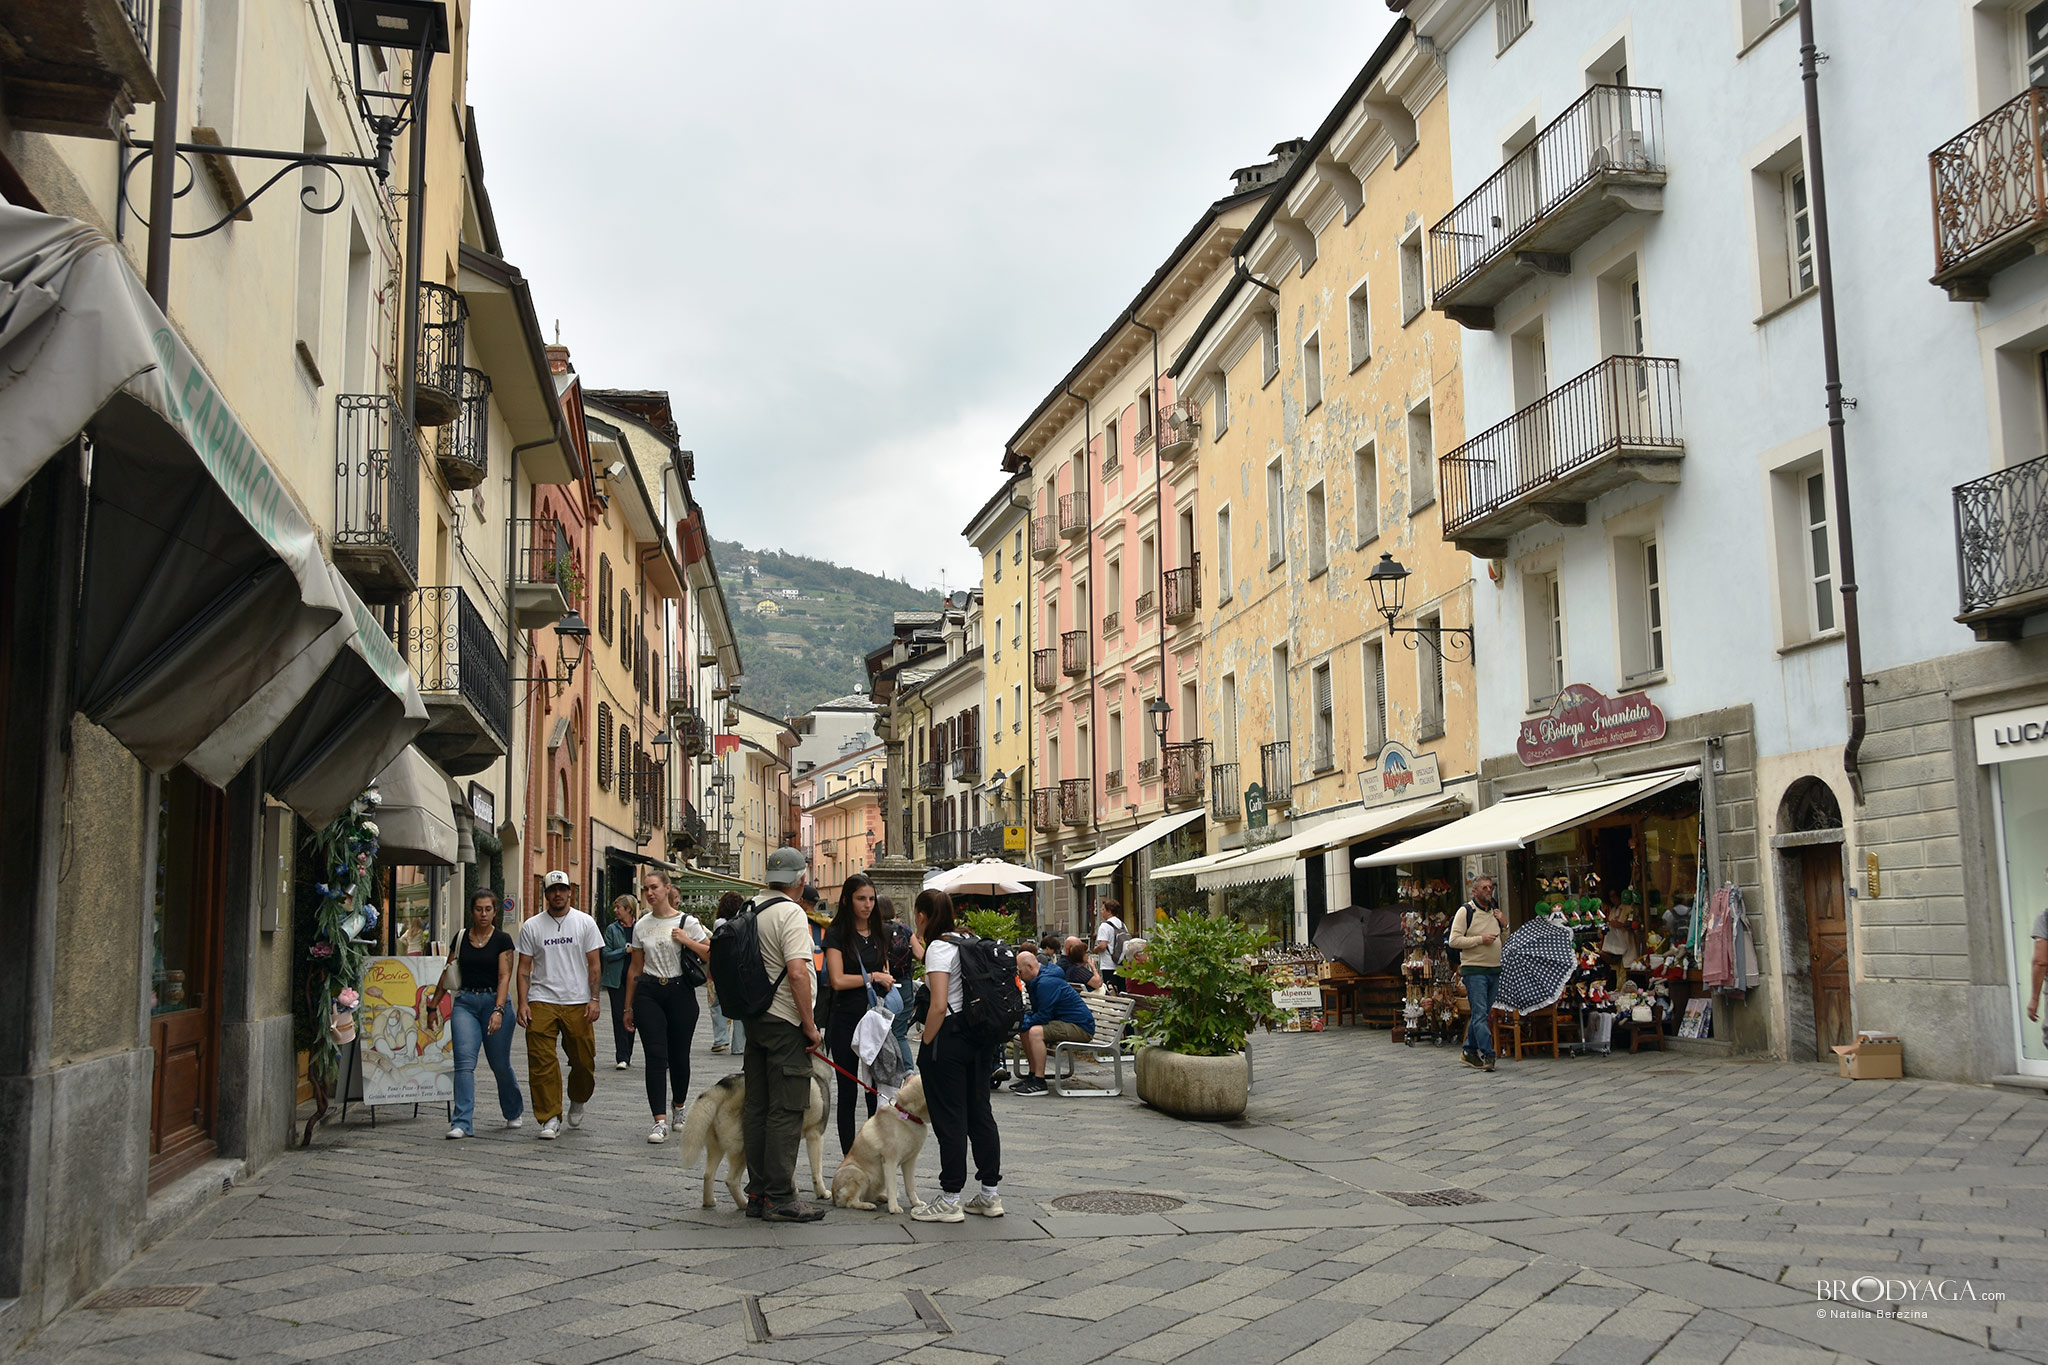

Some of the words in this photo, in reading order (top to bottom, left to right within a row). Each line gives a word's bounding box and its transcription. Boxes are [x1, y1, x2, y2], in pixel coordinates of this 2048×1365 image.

[181, 366, 288, 555] FARMACIA
[1524, 727, 1538, 745] La
[1540, 717, 1585, 747] Bottega
[1590, 703, 1650, 734] Incantata
[1580, 736, 1608, 748] Laboratorio
[1716, 760, 1721, 769] 6
[375, 966, 410, 982] Bovio
[1281, 990, 1312, 998] Alpenzu
